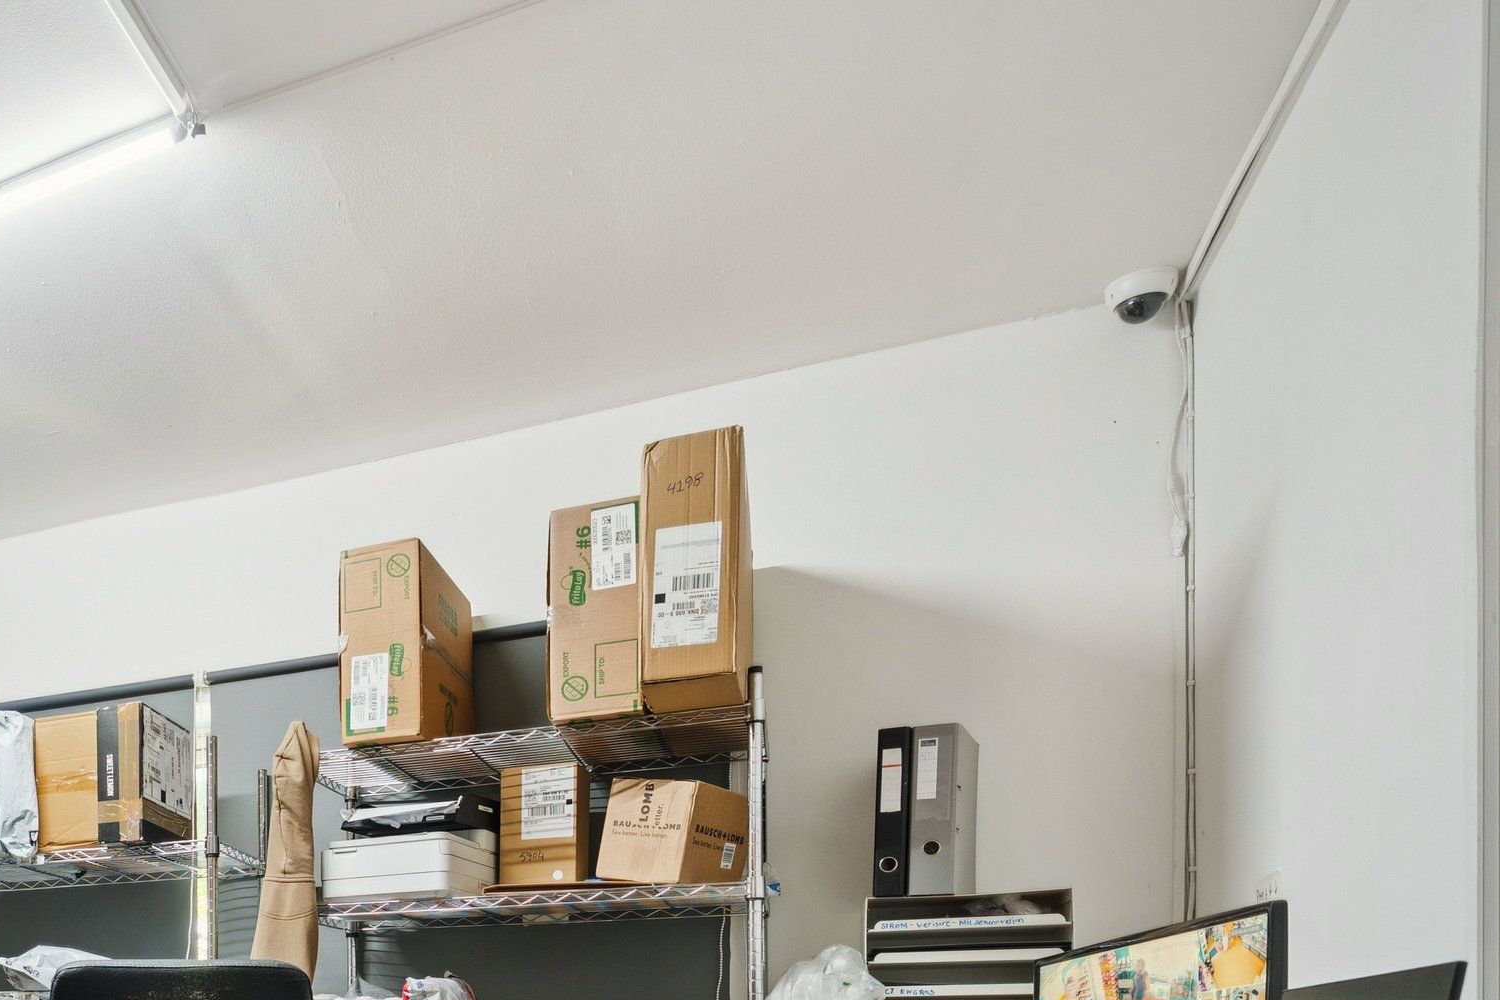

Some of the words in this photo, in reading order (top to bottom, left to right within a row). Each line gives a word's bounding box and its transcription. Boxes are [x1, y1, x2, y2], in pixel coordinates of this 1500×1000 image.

[667, 472, 704, 494] 4198
[105, 754, 114, 775] SWEET
[639, 783, 655, 822] LOMB
